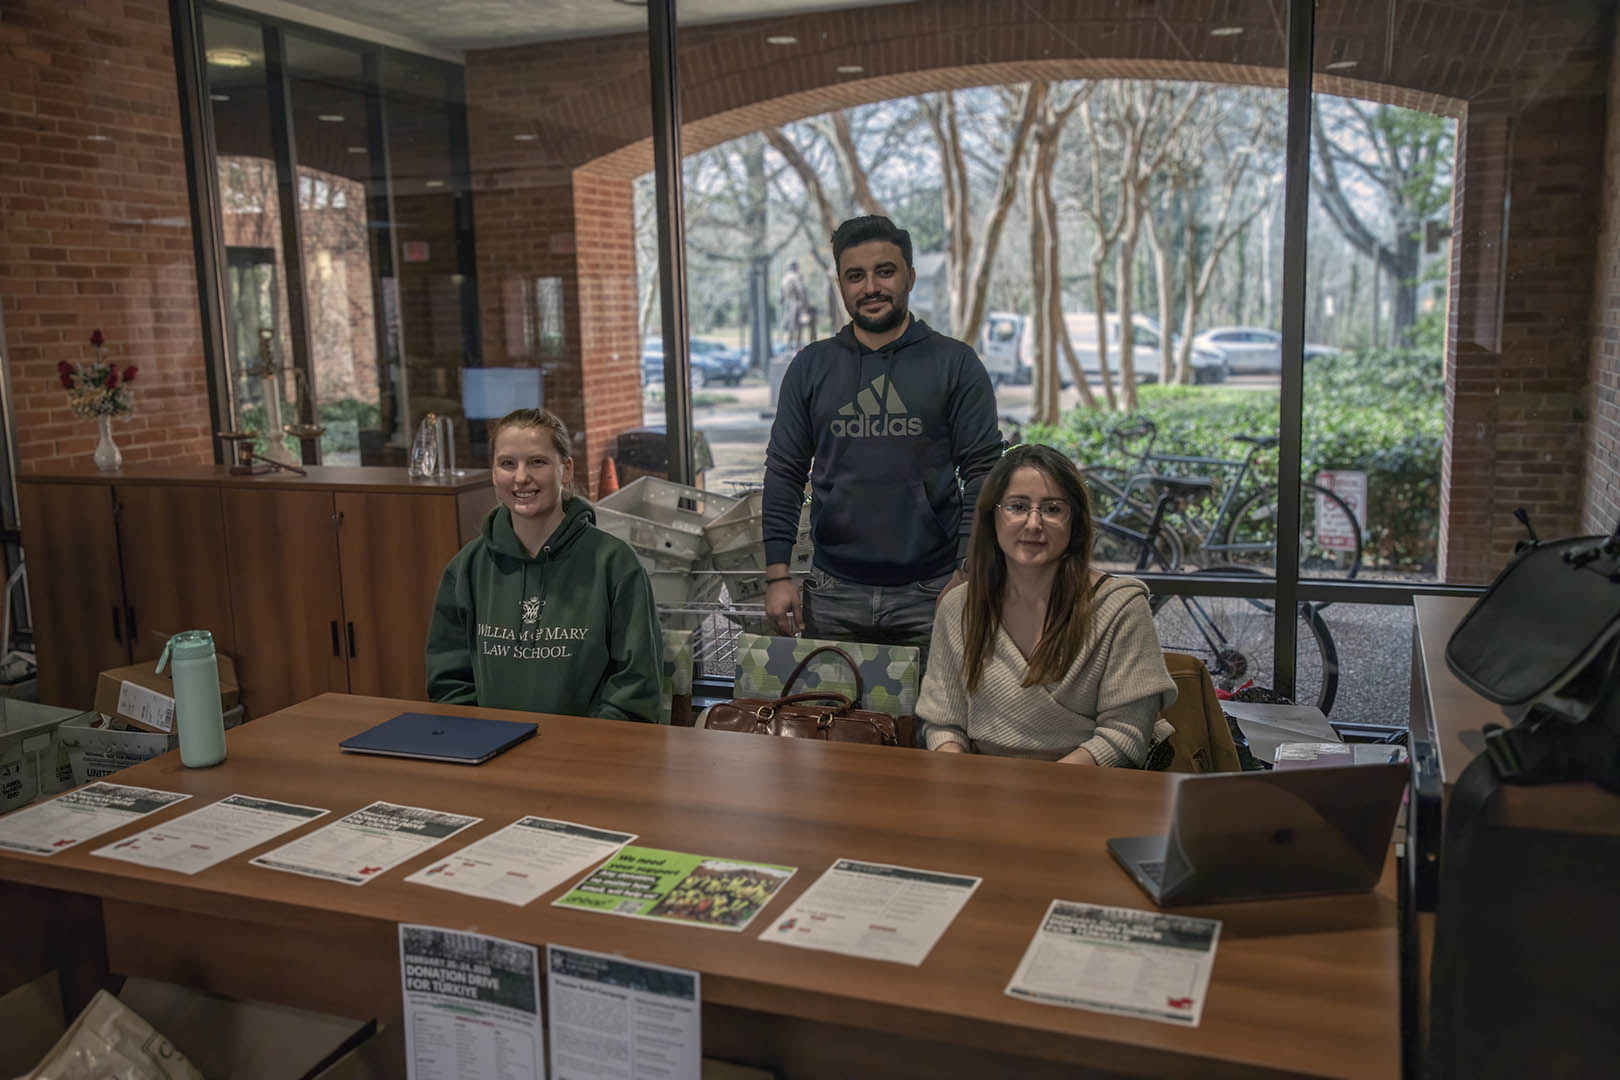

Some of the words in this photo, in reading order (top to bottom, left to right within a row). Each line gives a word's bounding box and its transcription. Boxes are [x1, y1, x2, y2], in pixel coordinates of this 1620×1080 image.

[830, 413, 923, 438] adidas
[478, 623, 528, 641] WILLIAM
[545, 626, 588, 640] MARY
[483, 641, 511, 657] LAW
[513, 645, 570, 659] SCHOOL
[406, 964, 467, 984] DONATION
[468, 974, 500, 991] DRIVE
[407, 977, 431, 991] FOR
